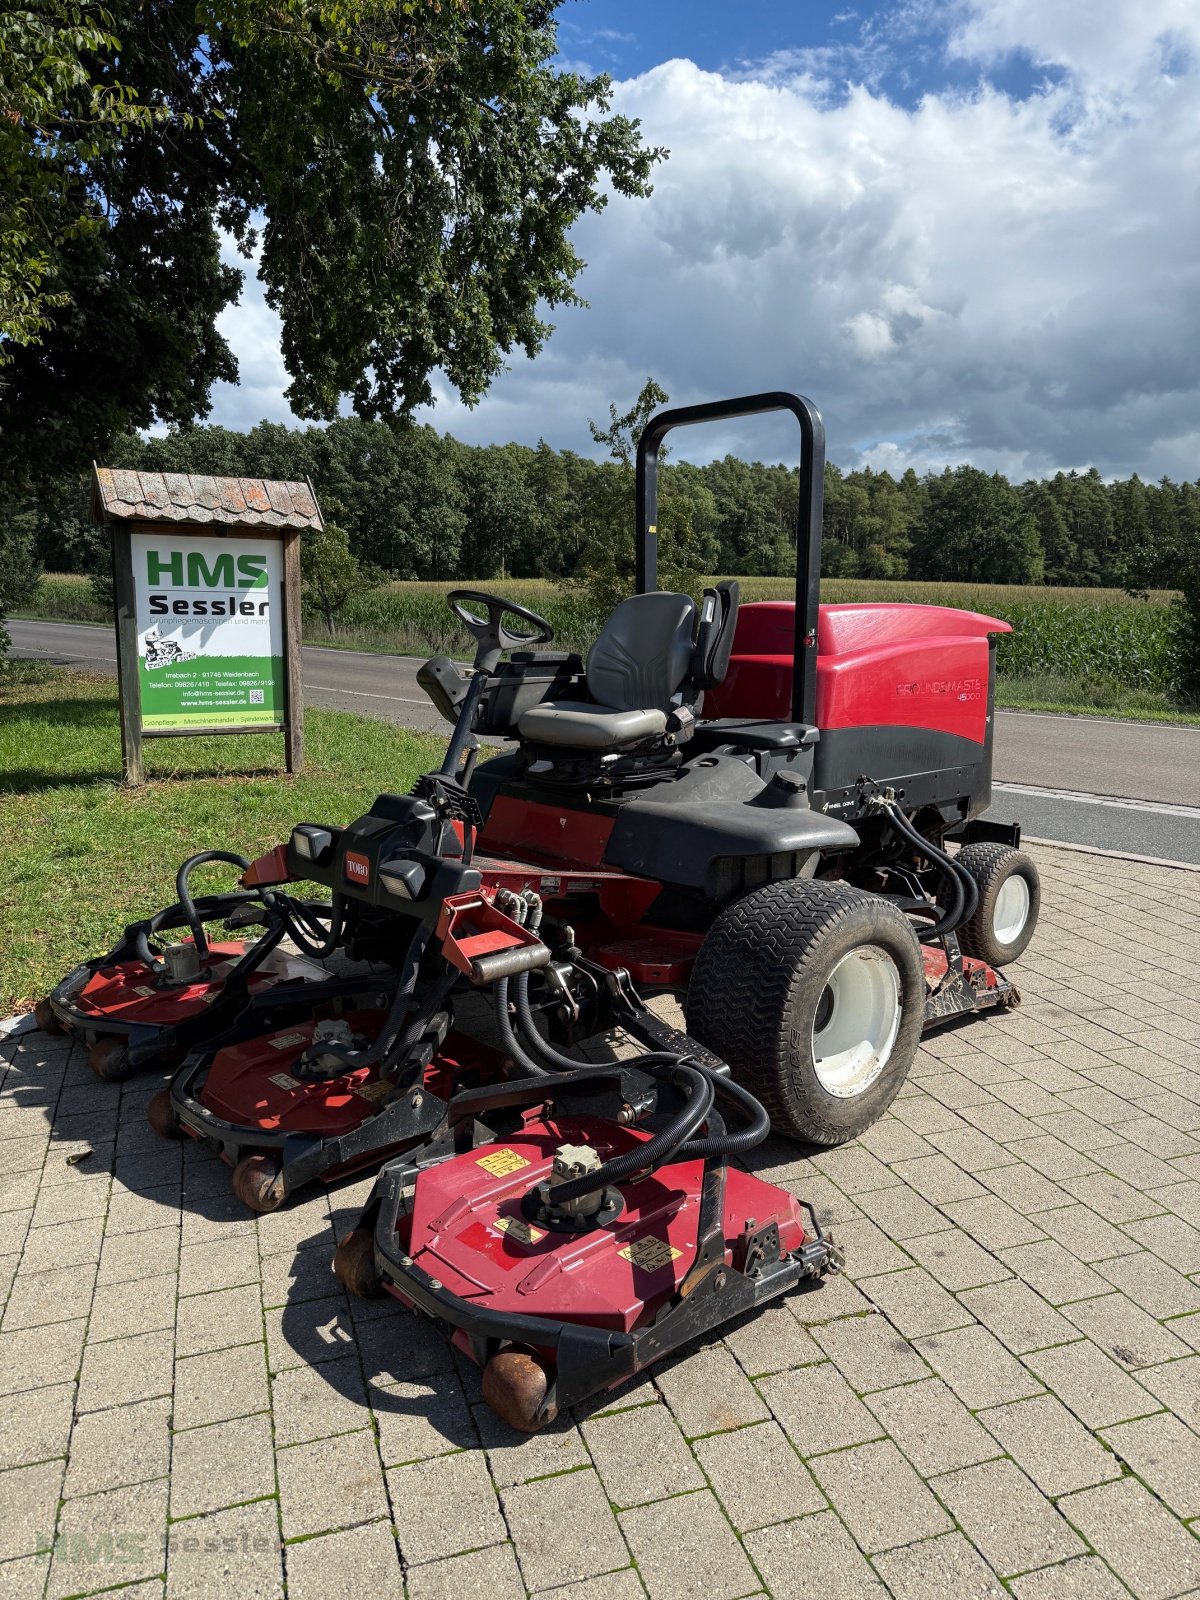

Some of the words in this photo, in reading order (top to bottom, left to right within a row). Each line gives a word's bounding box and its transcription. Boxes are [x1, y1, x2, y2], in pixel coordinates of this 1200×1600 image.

[147, 551, 269, 588] HMS
[149, 595, 269, 616] Sessler
[234, 617, 248, 625] und
[181, 699, 247, 707] www.hms-sessler.de
[183, 717, 235, 725] Maschinenhandel
[347, 860, 368, 877] TORO
